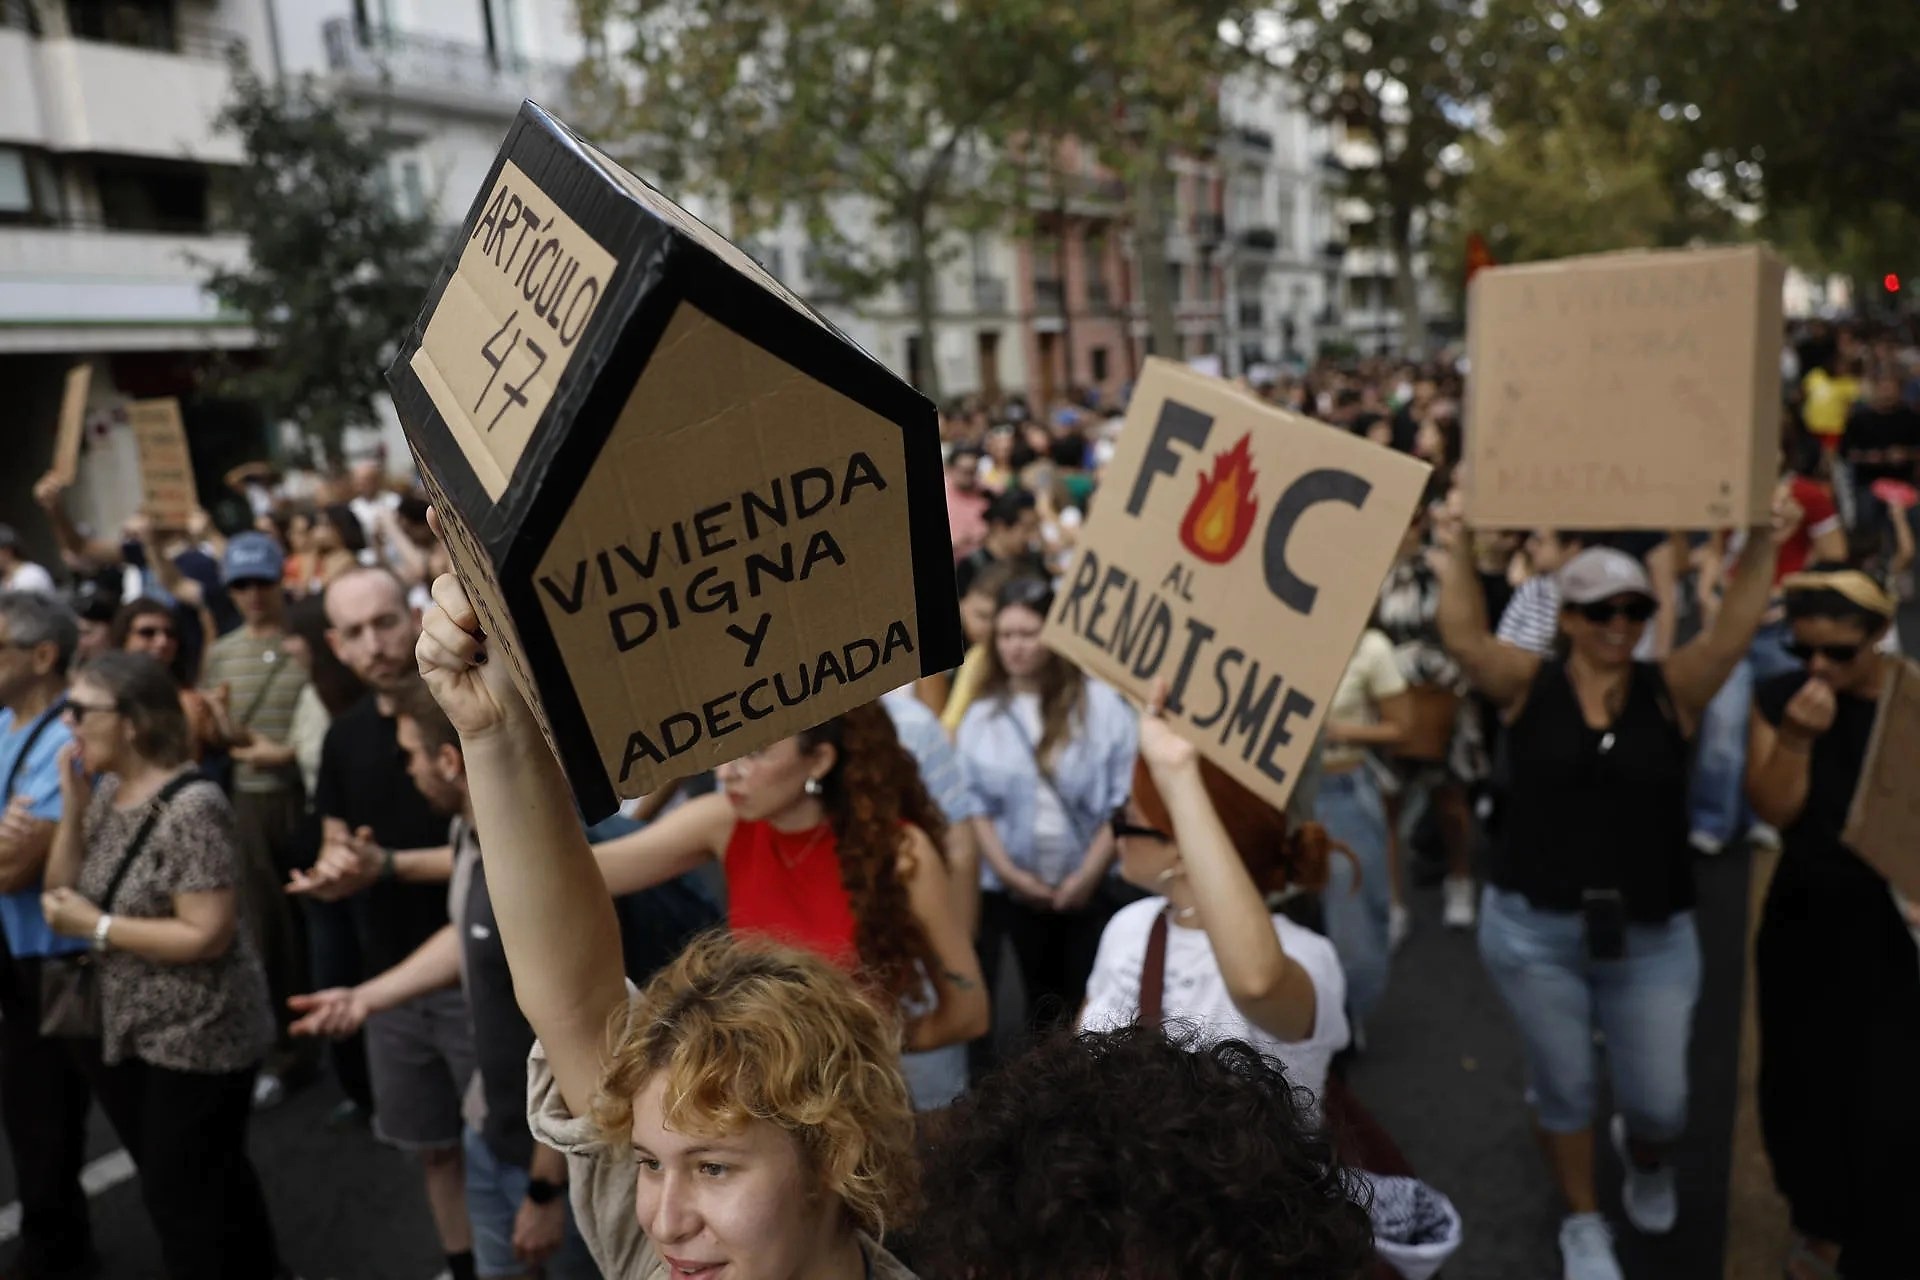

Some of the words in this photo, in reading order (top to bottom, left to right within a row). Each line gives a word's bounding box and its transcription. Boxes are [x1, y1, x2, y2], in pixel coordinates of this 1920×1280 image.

[473, 310, 547, 433] 47
[539, 451, 887, 614] VIVIENDA
[609, 530, 846, 652] DIGNA
[1161, 562, 1195, 602] AL
[726, 612, 772, 667] Y
[1058, 550, 1316, 785] RENDISME
[618, 620, 915, 783] ADECUADA
